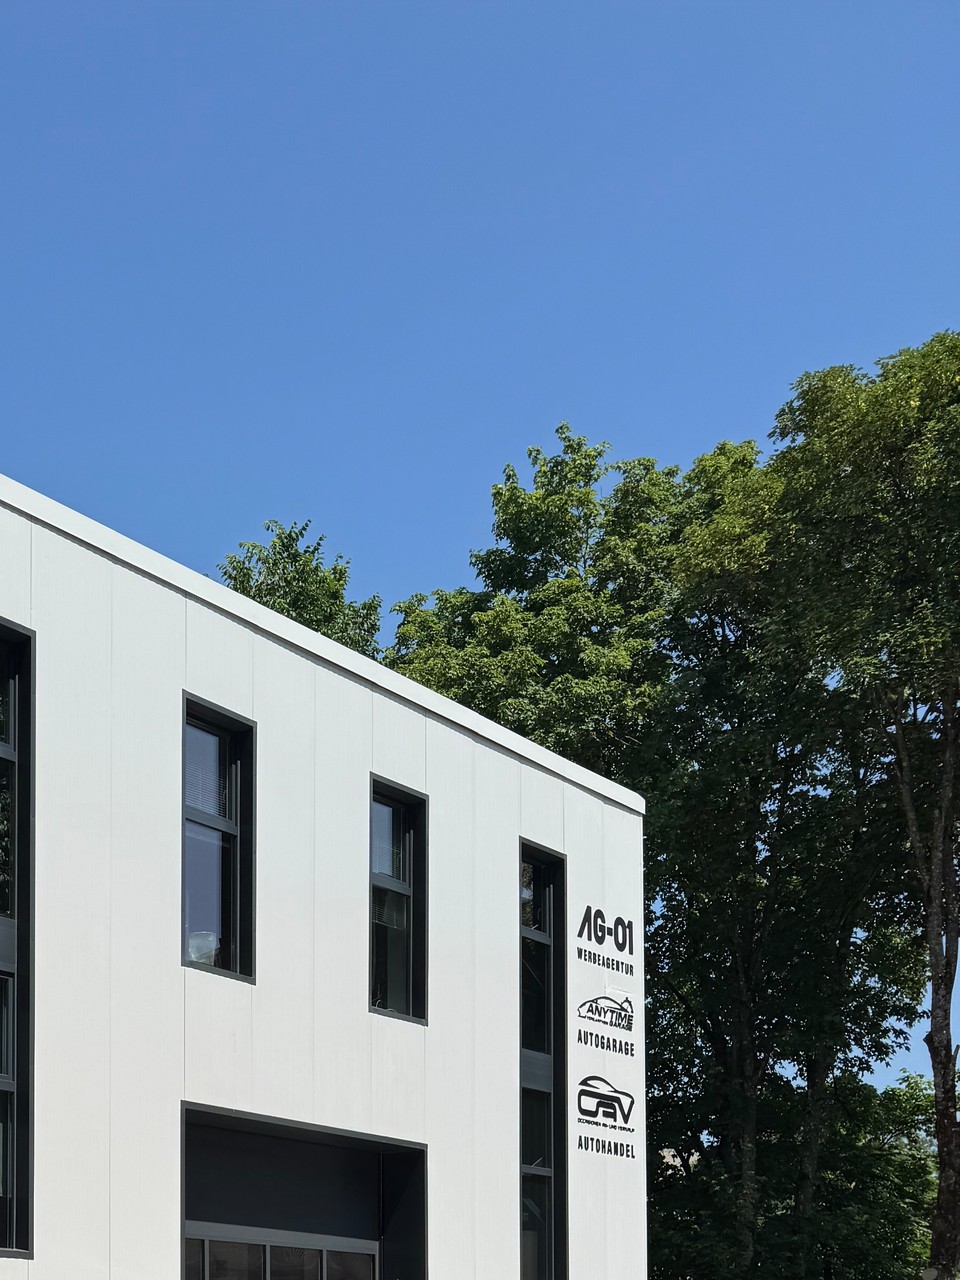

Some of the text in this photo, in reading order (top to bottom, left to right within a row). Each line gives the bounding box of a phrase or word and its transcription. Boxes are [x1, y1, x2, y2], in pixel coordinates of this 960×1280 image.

[576, 904, 634, 956] AG-01
[576, 946, 634, 977] WERBEAGENTUR
[586, 1003, 634, 1025] ANYTIME
[577, 1028, 635, 1058] AUTOGARAGE
[577, 1134, 636, 1160] AUTOHANDEL
